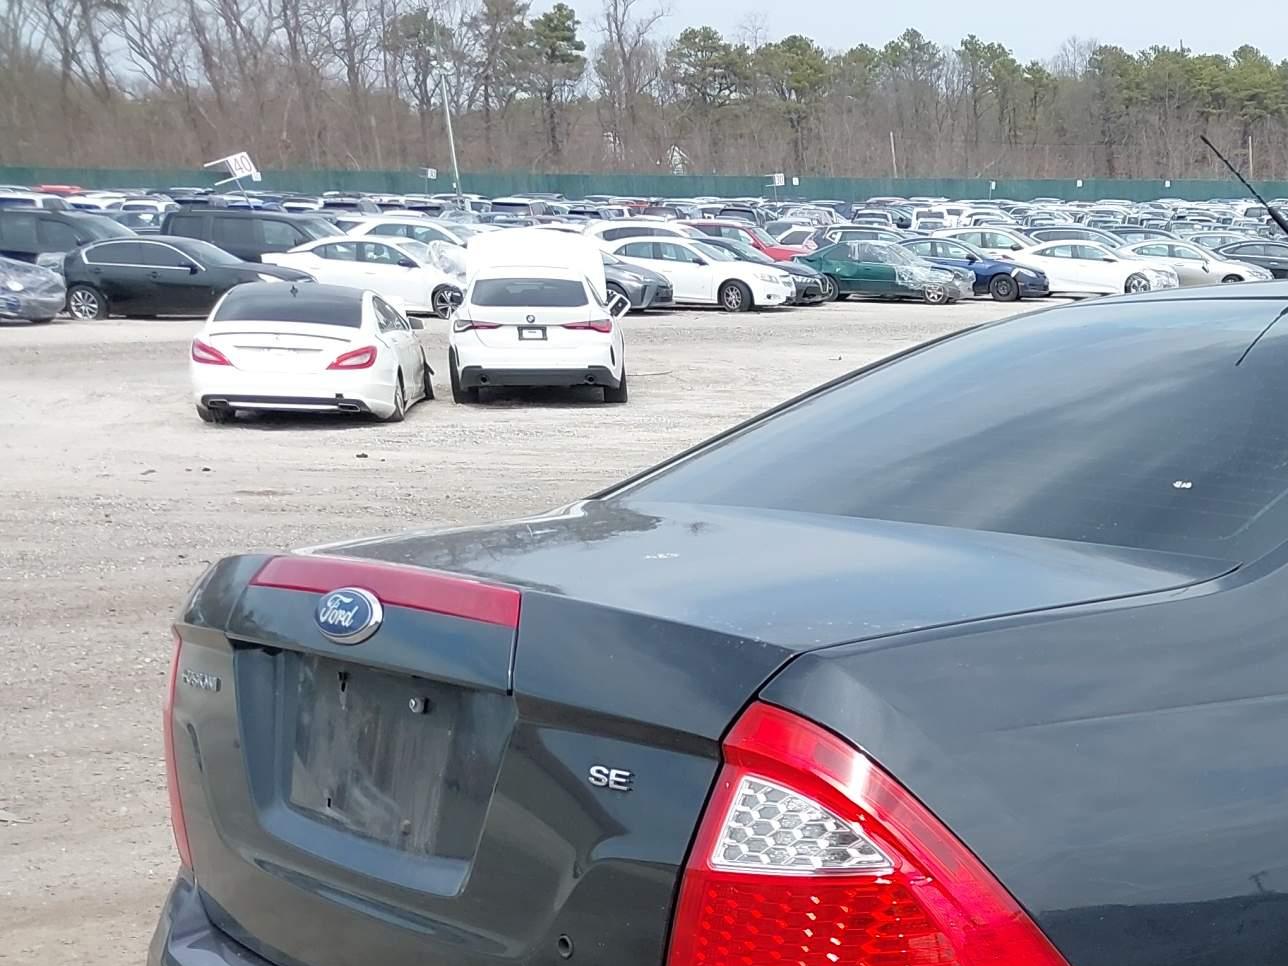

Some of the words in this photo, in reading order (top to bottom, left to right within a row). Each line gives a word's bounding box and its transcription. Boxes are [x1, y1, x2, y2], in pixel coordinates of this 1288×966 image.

[233, 155, 253, 173] 40
[319, 594, 358, 627] Ford
[588, 765, 632, 791] SE
